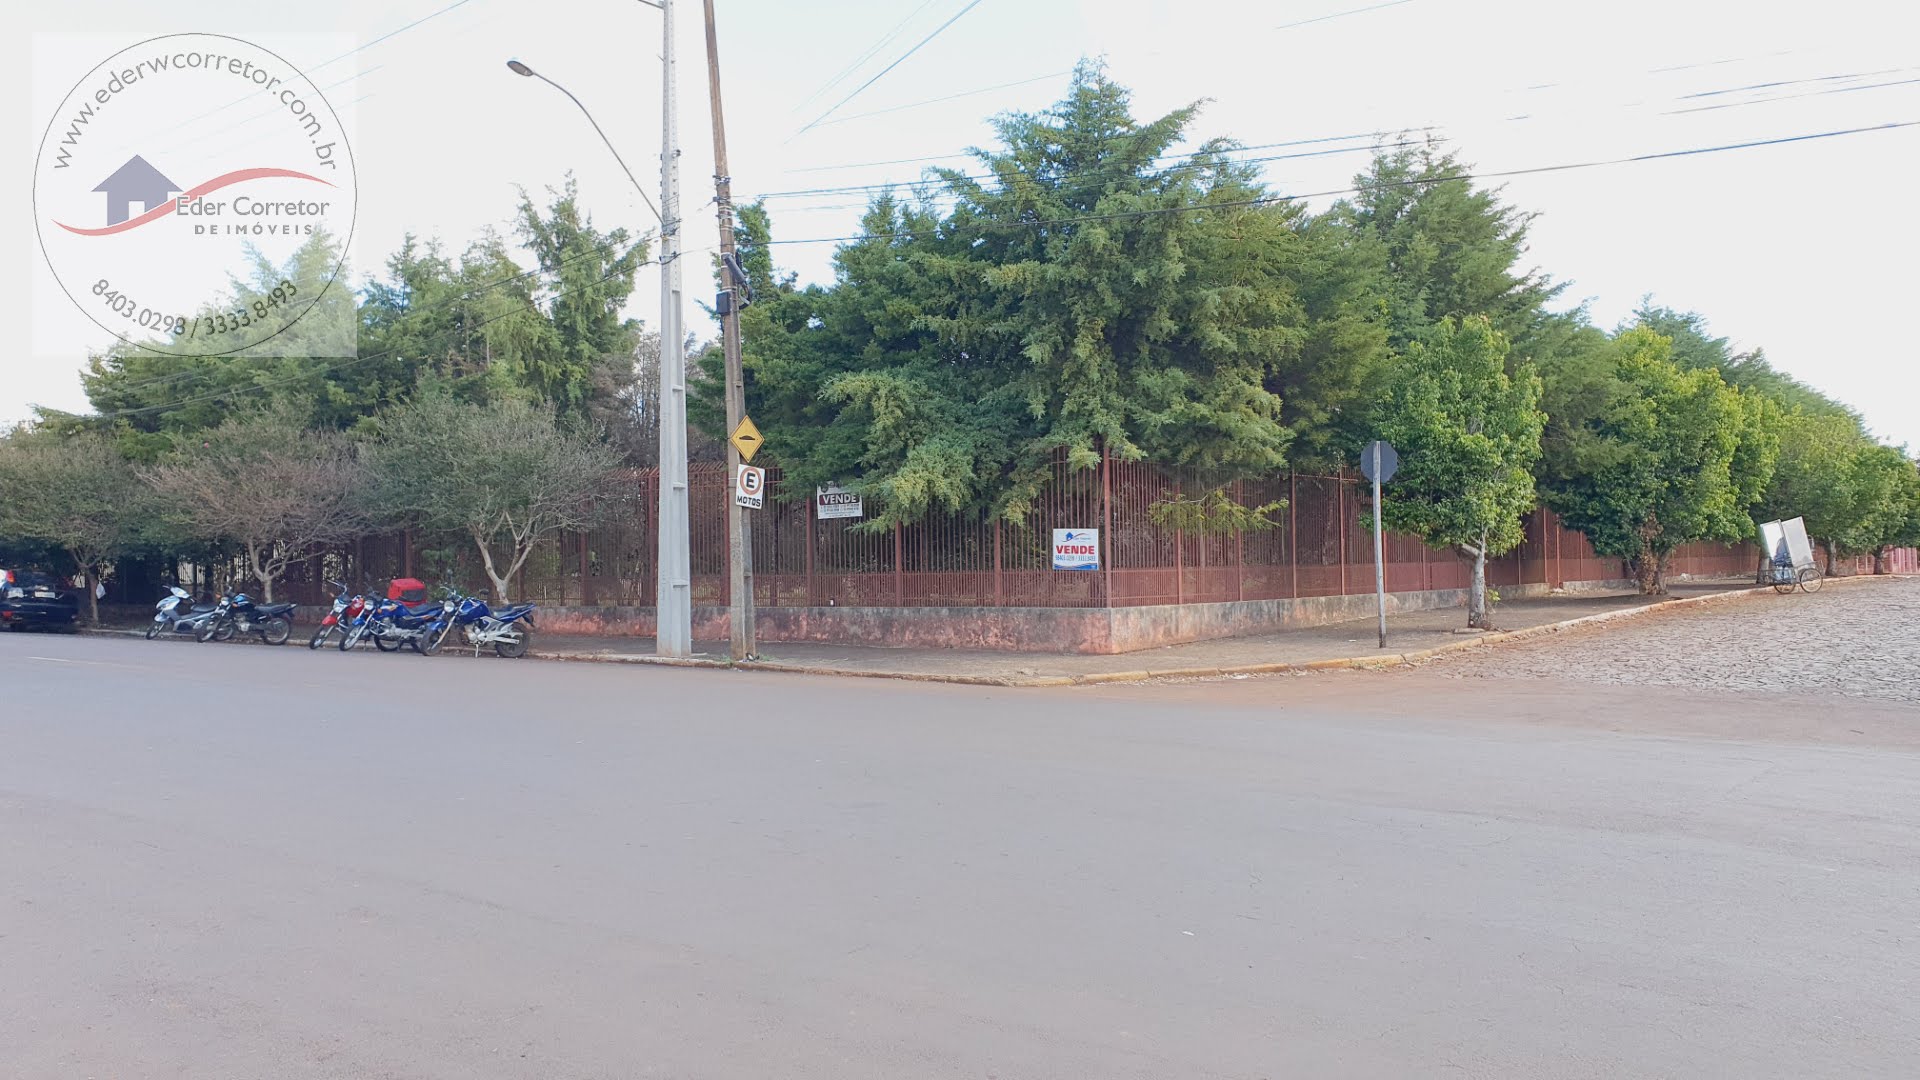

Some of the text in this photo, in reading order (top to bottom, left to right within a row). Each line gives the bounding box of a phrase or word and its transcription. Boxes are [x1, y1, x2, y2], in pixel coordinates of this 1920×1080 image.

[745, 472, 756, 489] E
[736, 495, 761, 507] MOTOS
[822, 493, 857, 504] VENDE
[1055, 545, 1095, 555] VENDE
